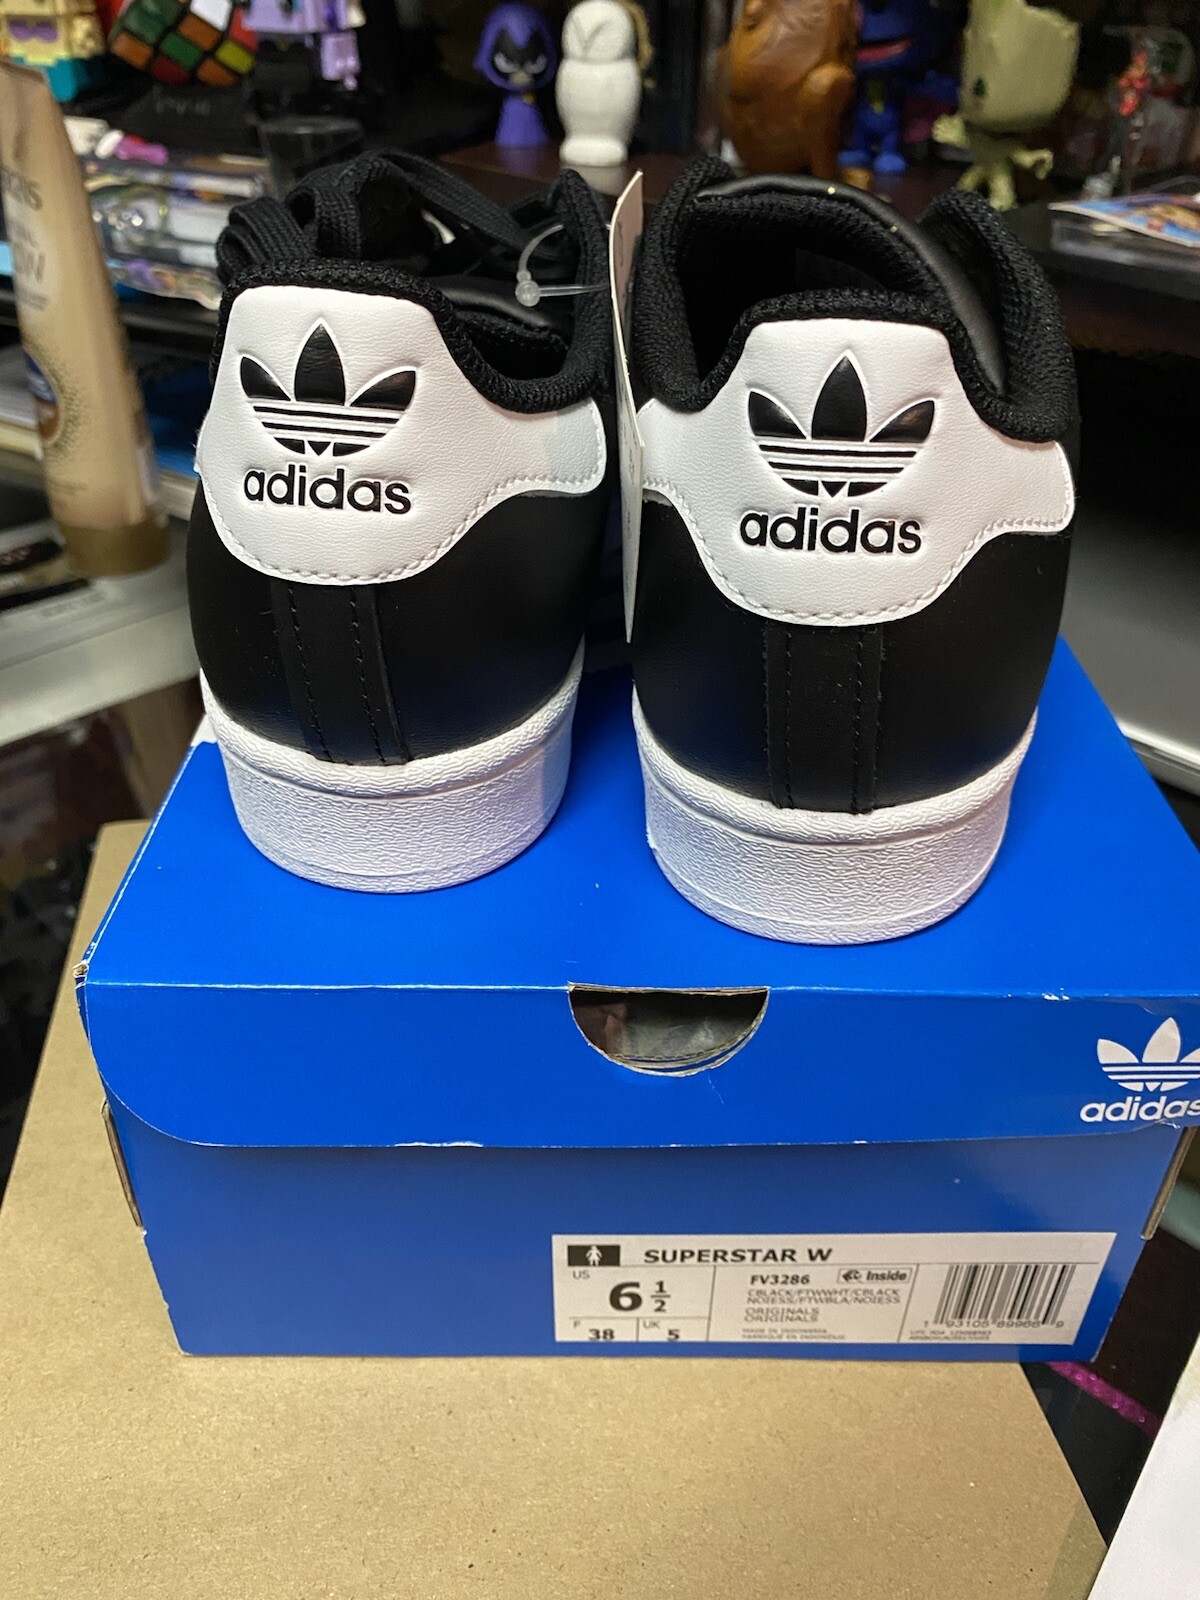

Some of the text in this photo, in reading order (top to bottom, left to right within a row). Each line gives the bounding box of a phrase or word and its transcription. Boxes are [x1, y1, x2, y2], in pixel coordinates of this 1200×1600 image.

[243, 464, 411, 514] adidas
[739, 507, 922, 554] adidas
[1079, 1096, 1200, 1122] adidas
[643, 1248, 832, 1263] SUPERSTAR W
[572, 1270, 590, 1279] US
[750, 1274, 810, 1285] FV3286
[866, 1270, 908, 1281] Inside
[609, 1281, 643, 1312] 6
[744, 1307, 820, 1315] ORIGINALS
[643, 1320, 660, 1329] UK
[588, 1329, 615, 1341] 38
[667, 1329, 680, 1341] 5
